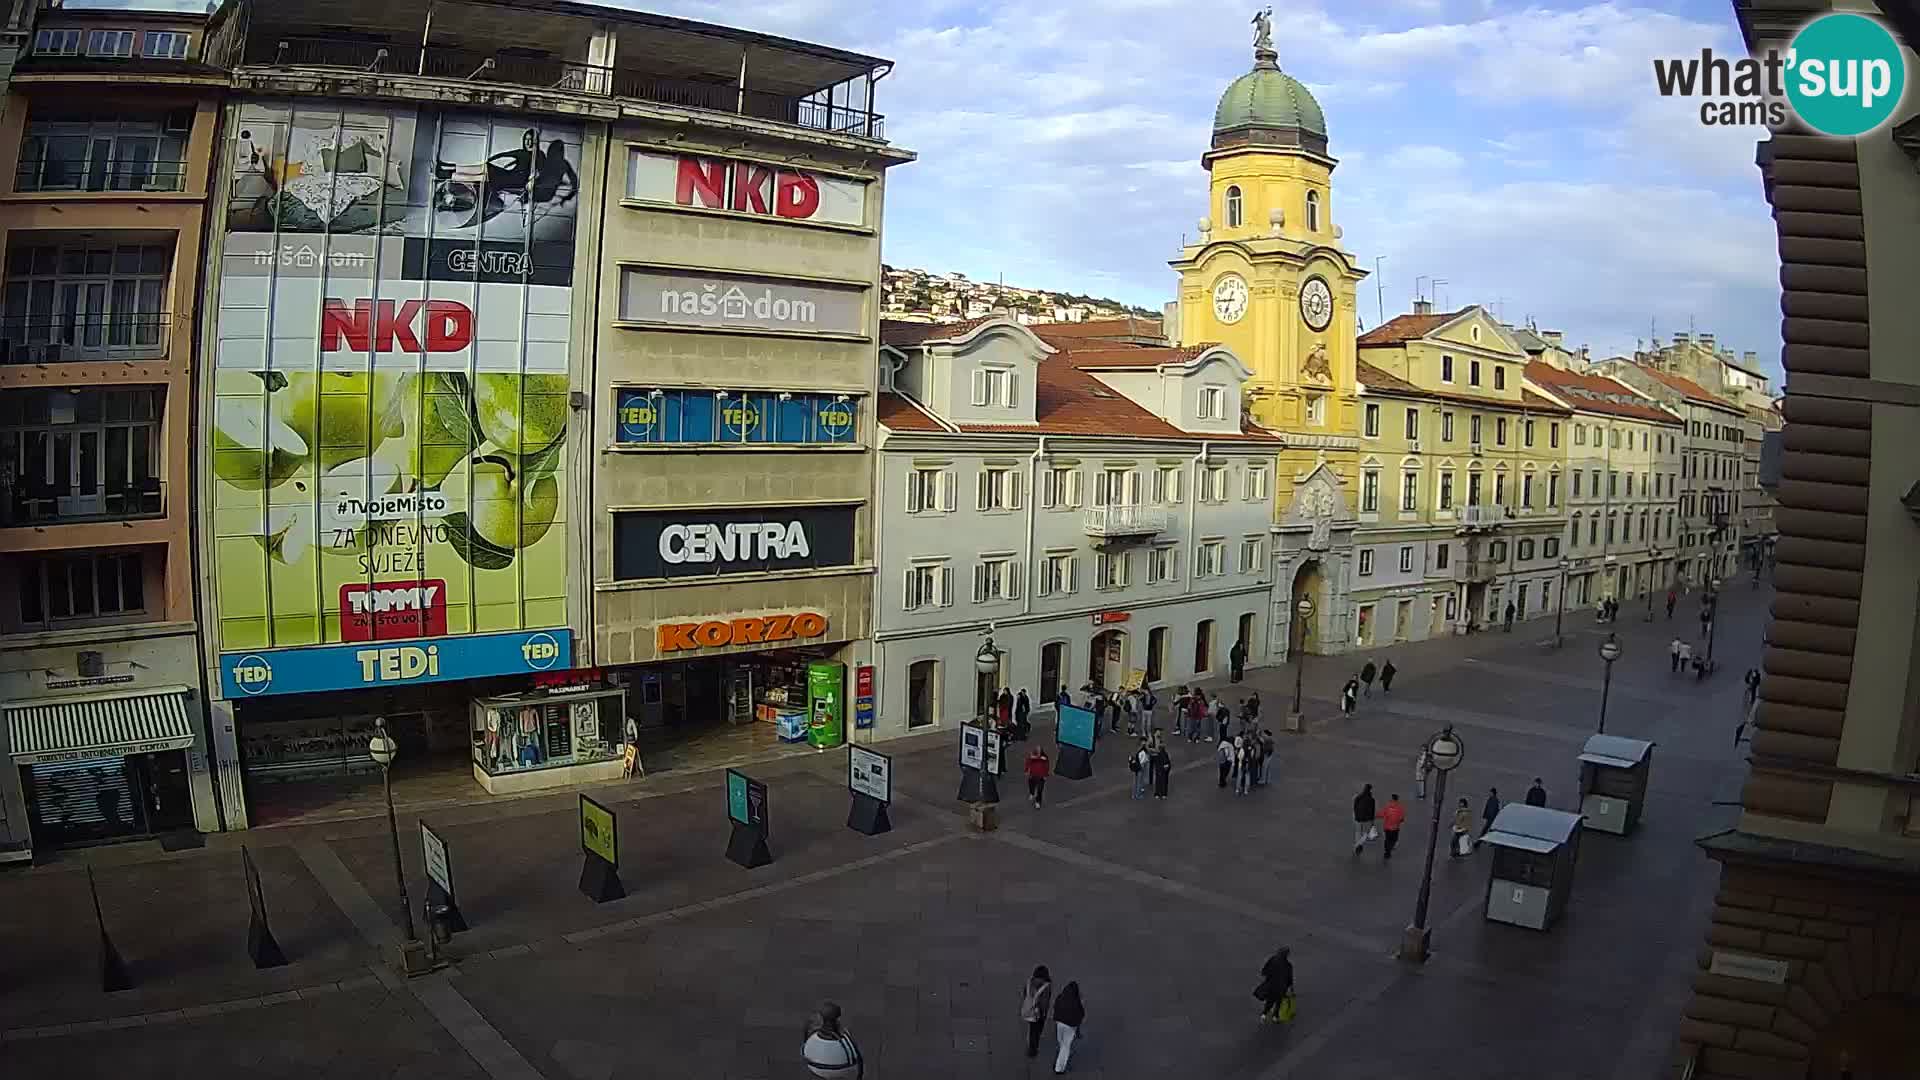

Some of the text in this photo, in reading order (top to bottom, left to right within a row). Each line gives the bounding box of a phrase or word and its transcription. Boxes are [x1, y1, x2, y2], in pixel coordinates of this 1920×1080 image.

[675, 158, 820, 219] NKD
[447, 249, 534, 275] CENTRA
[660, 283, 816, 323] naš dom
[321, 299, 475, 353] NKD
[618, 408, 657, 425] TEDi
[333, 524, 450, 549] ZA DNEVNO
[659, 521, 810, 564] CENTRA
[358, 547, 425, 575] SVJEŽE
[348, 586, 438, 614] TOMMY
[658, 612, 829, 652] KORZO
[357, 645, 440, 682] TEDi
[521, 643, 559, 660] TEDi
[233, 666, 272, 682] TEDi
